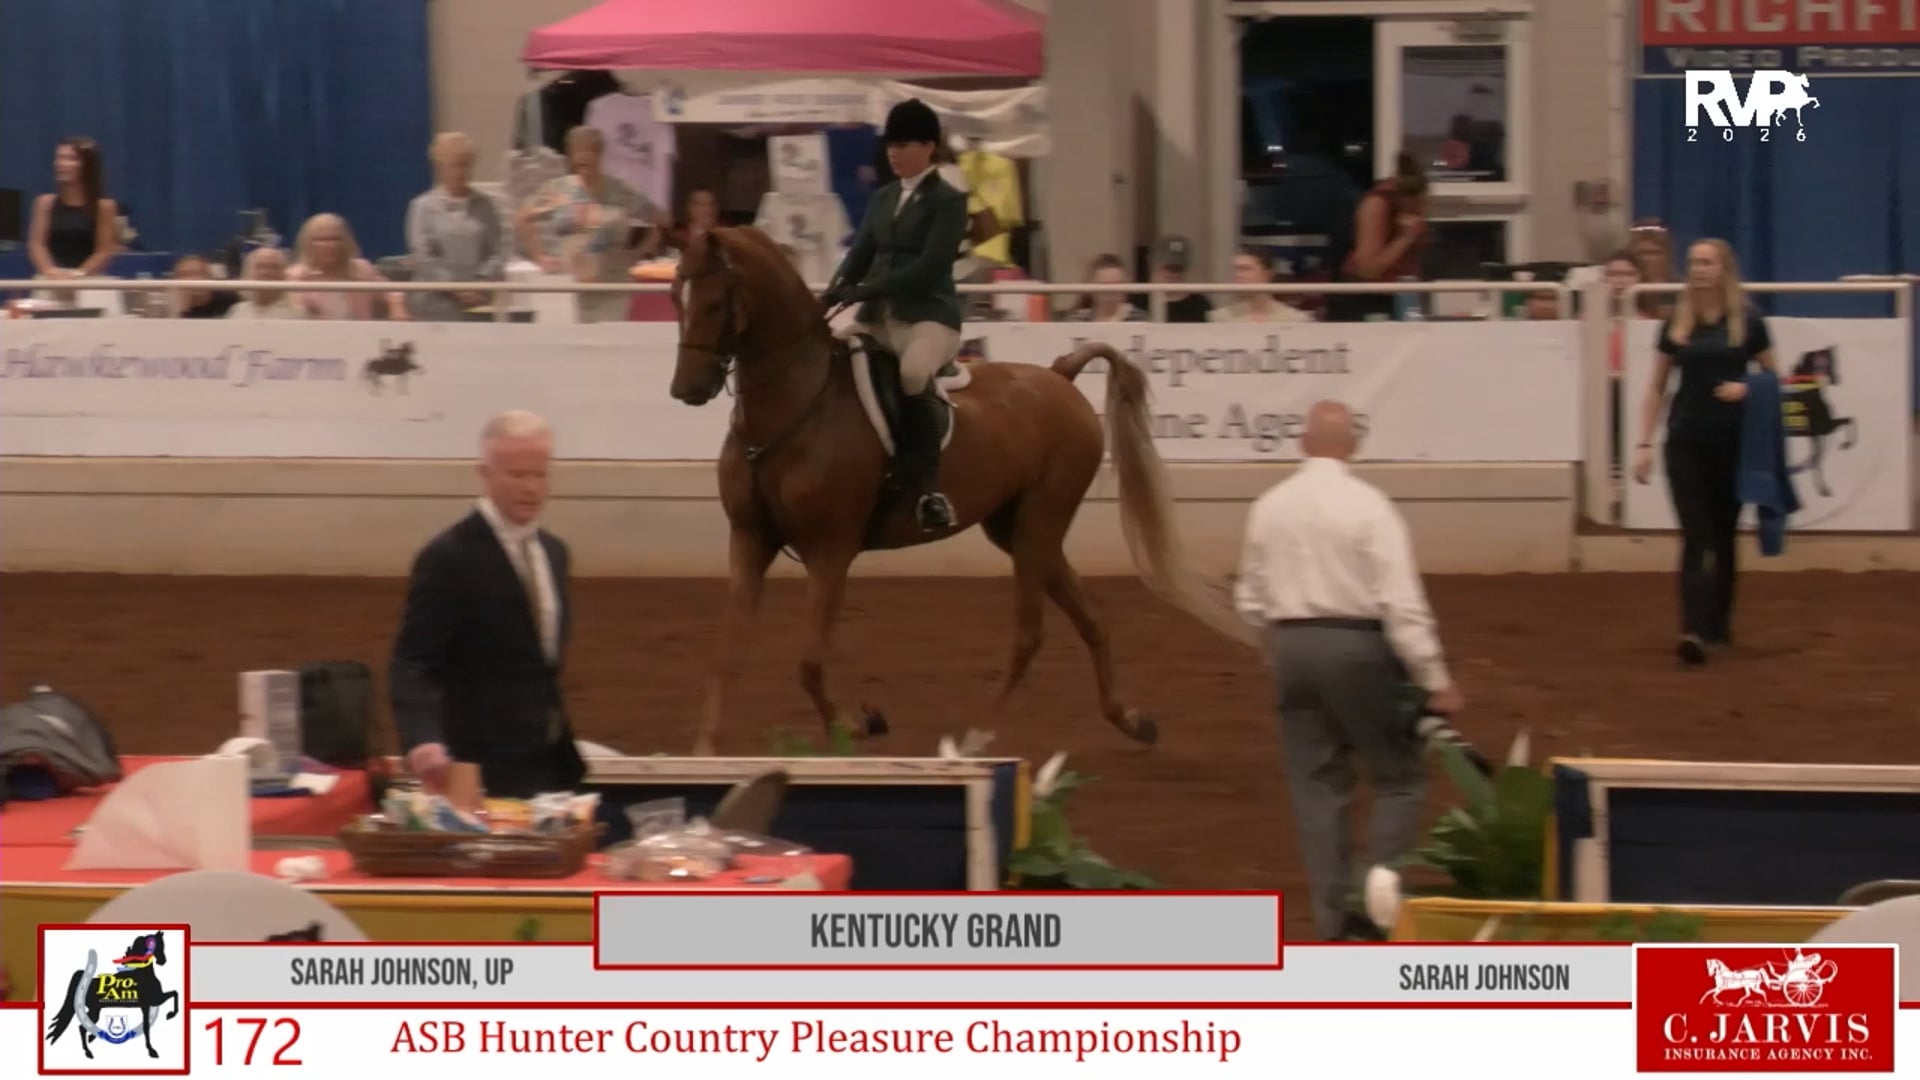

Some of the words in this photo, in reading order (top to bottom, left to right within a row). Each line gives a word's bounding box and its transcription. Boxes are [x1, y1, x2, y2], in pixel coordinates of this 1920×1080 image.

[1664, 47, 1782, 68] VIDEO
[231, 350, 346, 388] Farm
[1070, 334, 1351, 388] dependent
[1216, 402, 1371, 453] Ages
